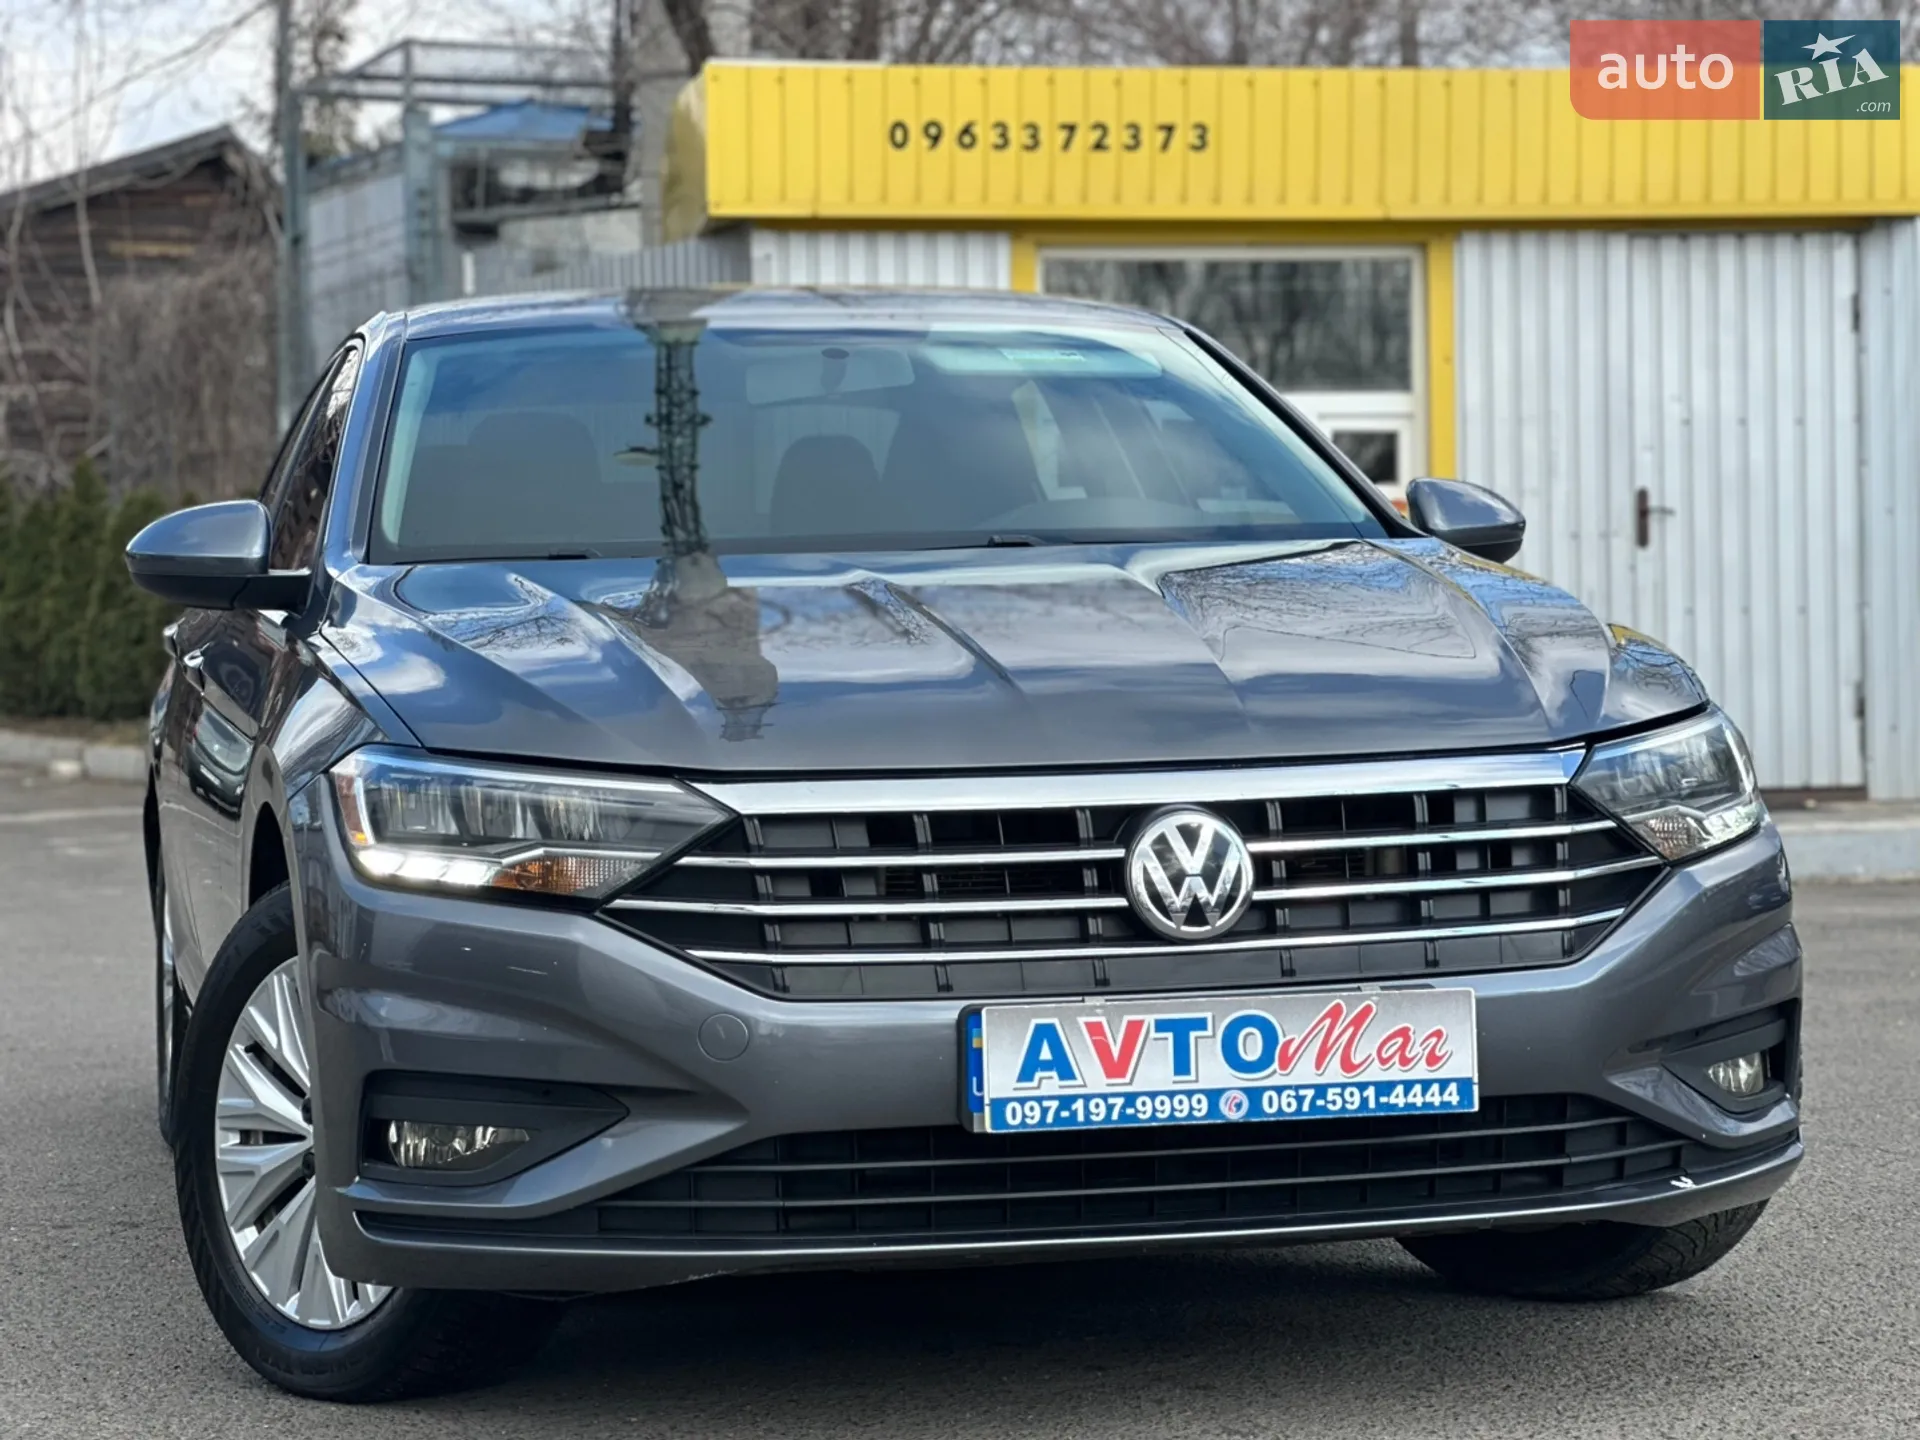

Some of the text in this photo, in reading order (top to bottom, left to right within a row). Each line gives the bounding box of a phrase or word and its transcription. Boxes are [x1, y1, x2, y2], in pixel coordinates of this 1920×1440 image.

[888, 119, 1210, 152] 0963372373
[1004, 1081, 1461, 1126] 097-197-9999 067-591-4444
